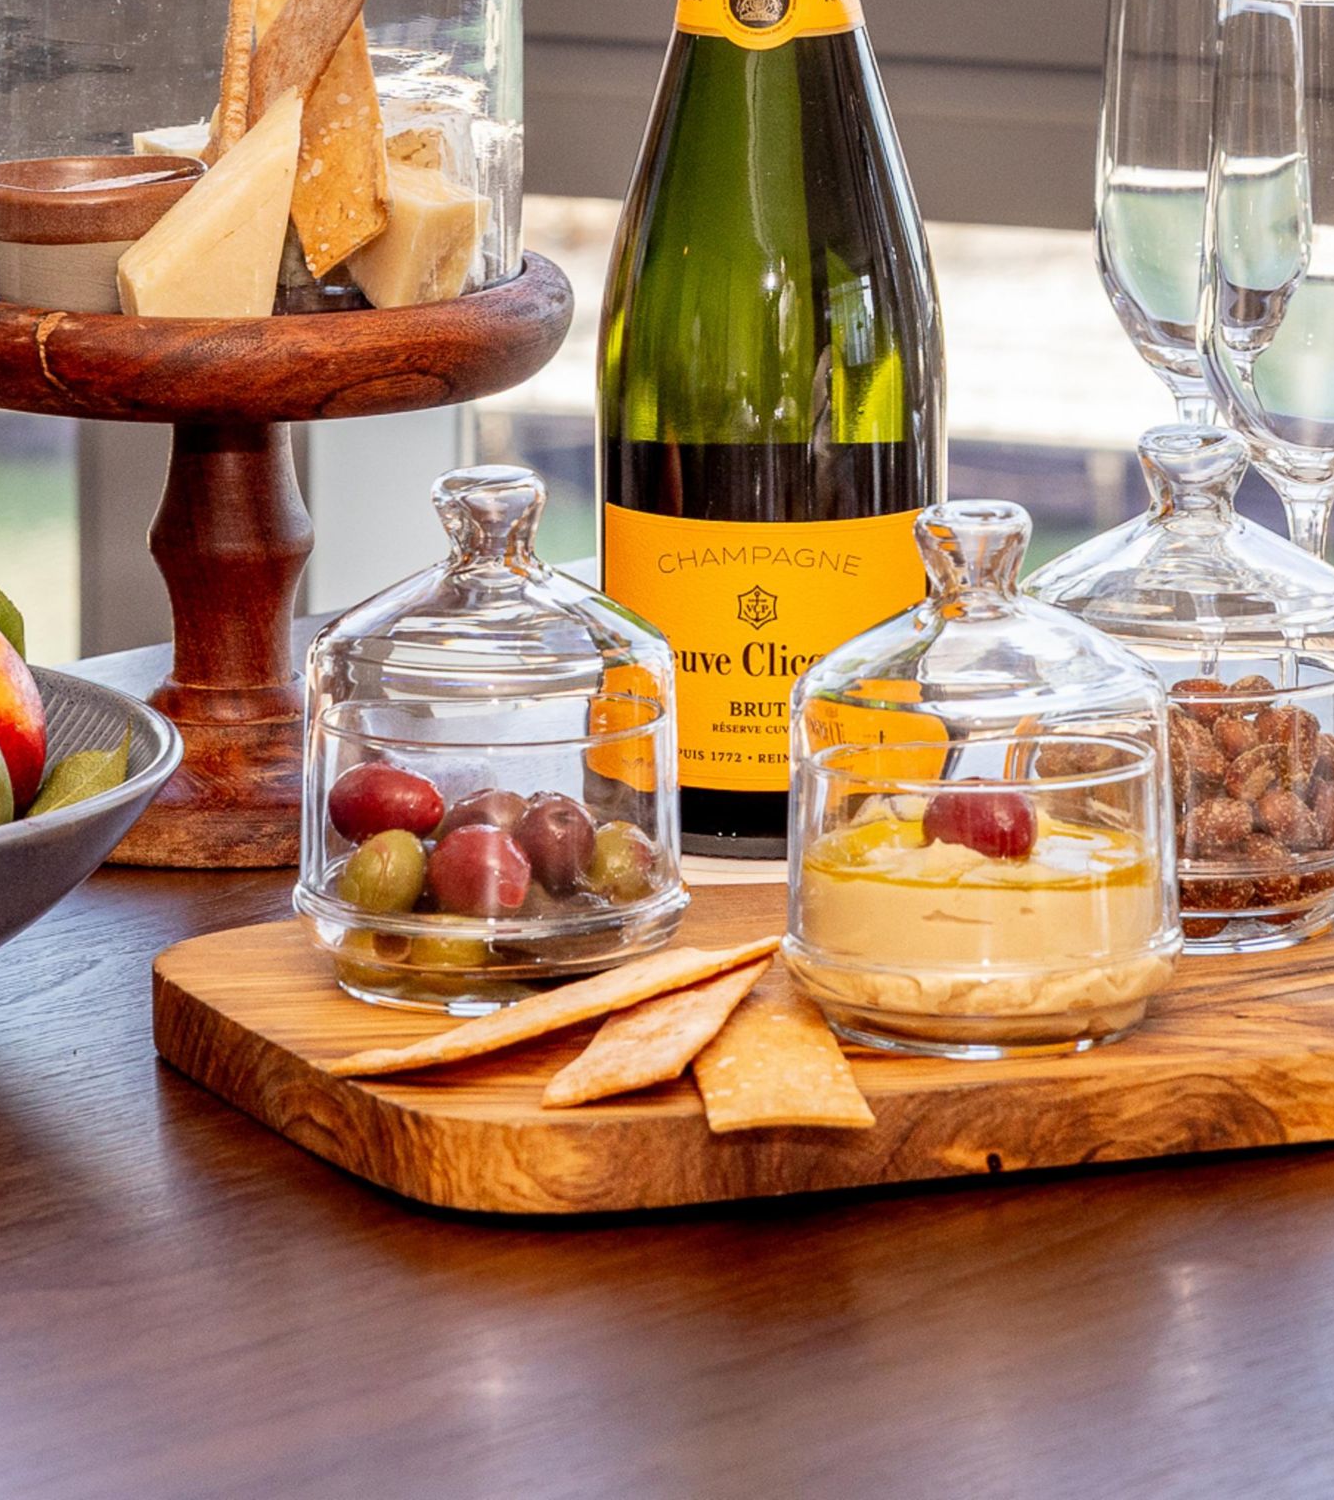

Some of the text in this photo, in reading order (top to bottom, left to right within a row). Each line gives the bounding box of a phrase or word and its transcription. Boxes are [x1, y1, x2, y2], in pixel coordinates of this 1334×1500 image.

[657, 545, 863, 577] CHAMPAGNE
[730, 701, 786, 717] BRUT
[712, 721, 762, 734] RÉSERVE
[711, 751, 742, 763] 1772
